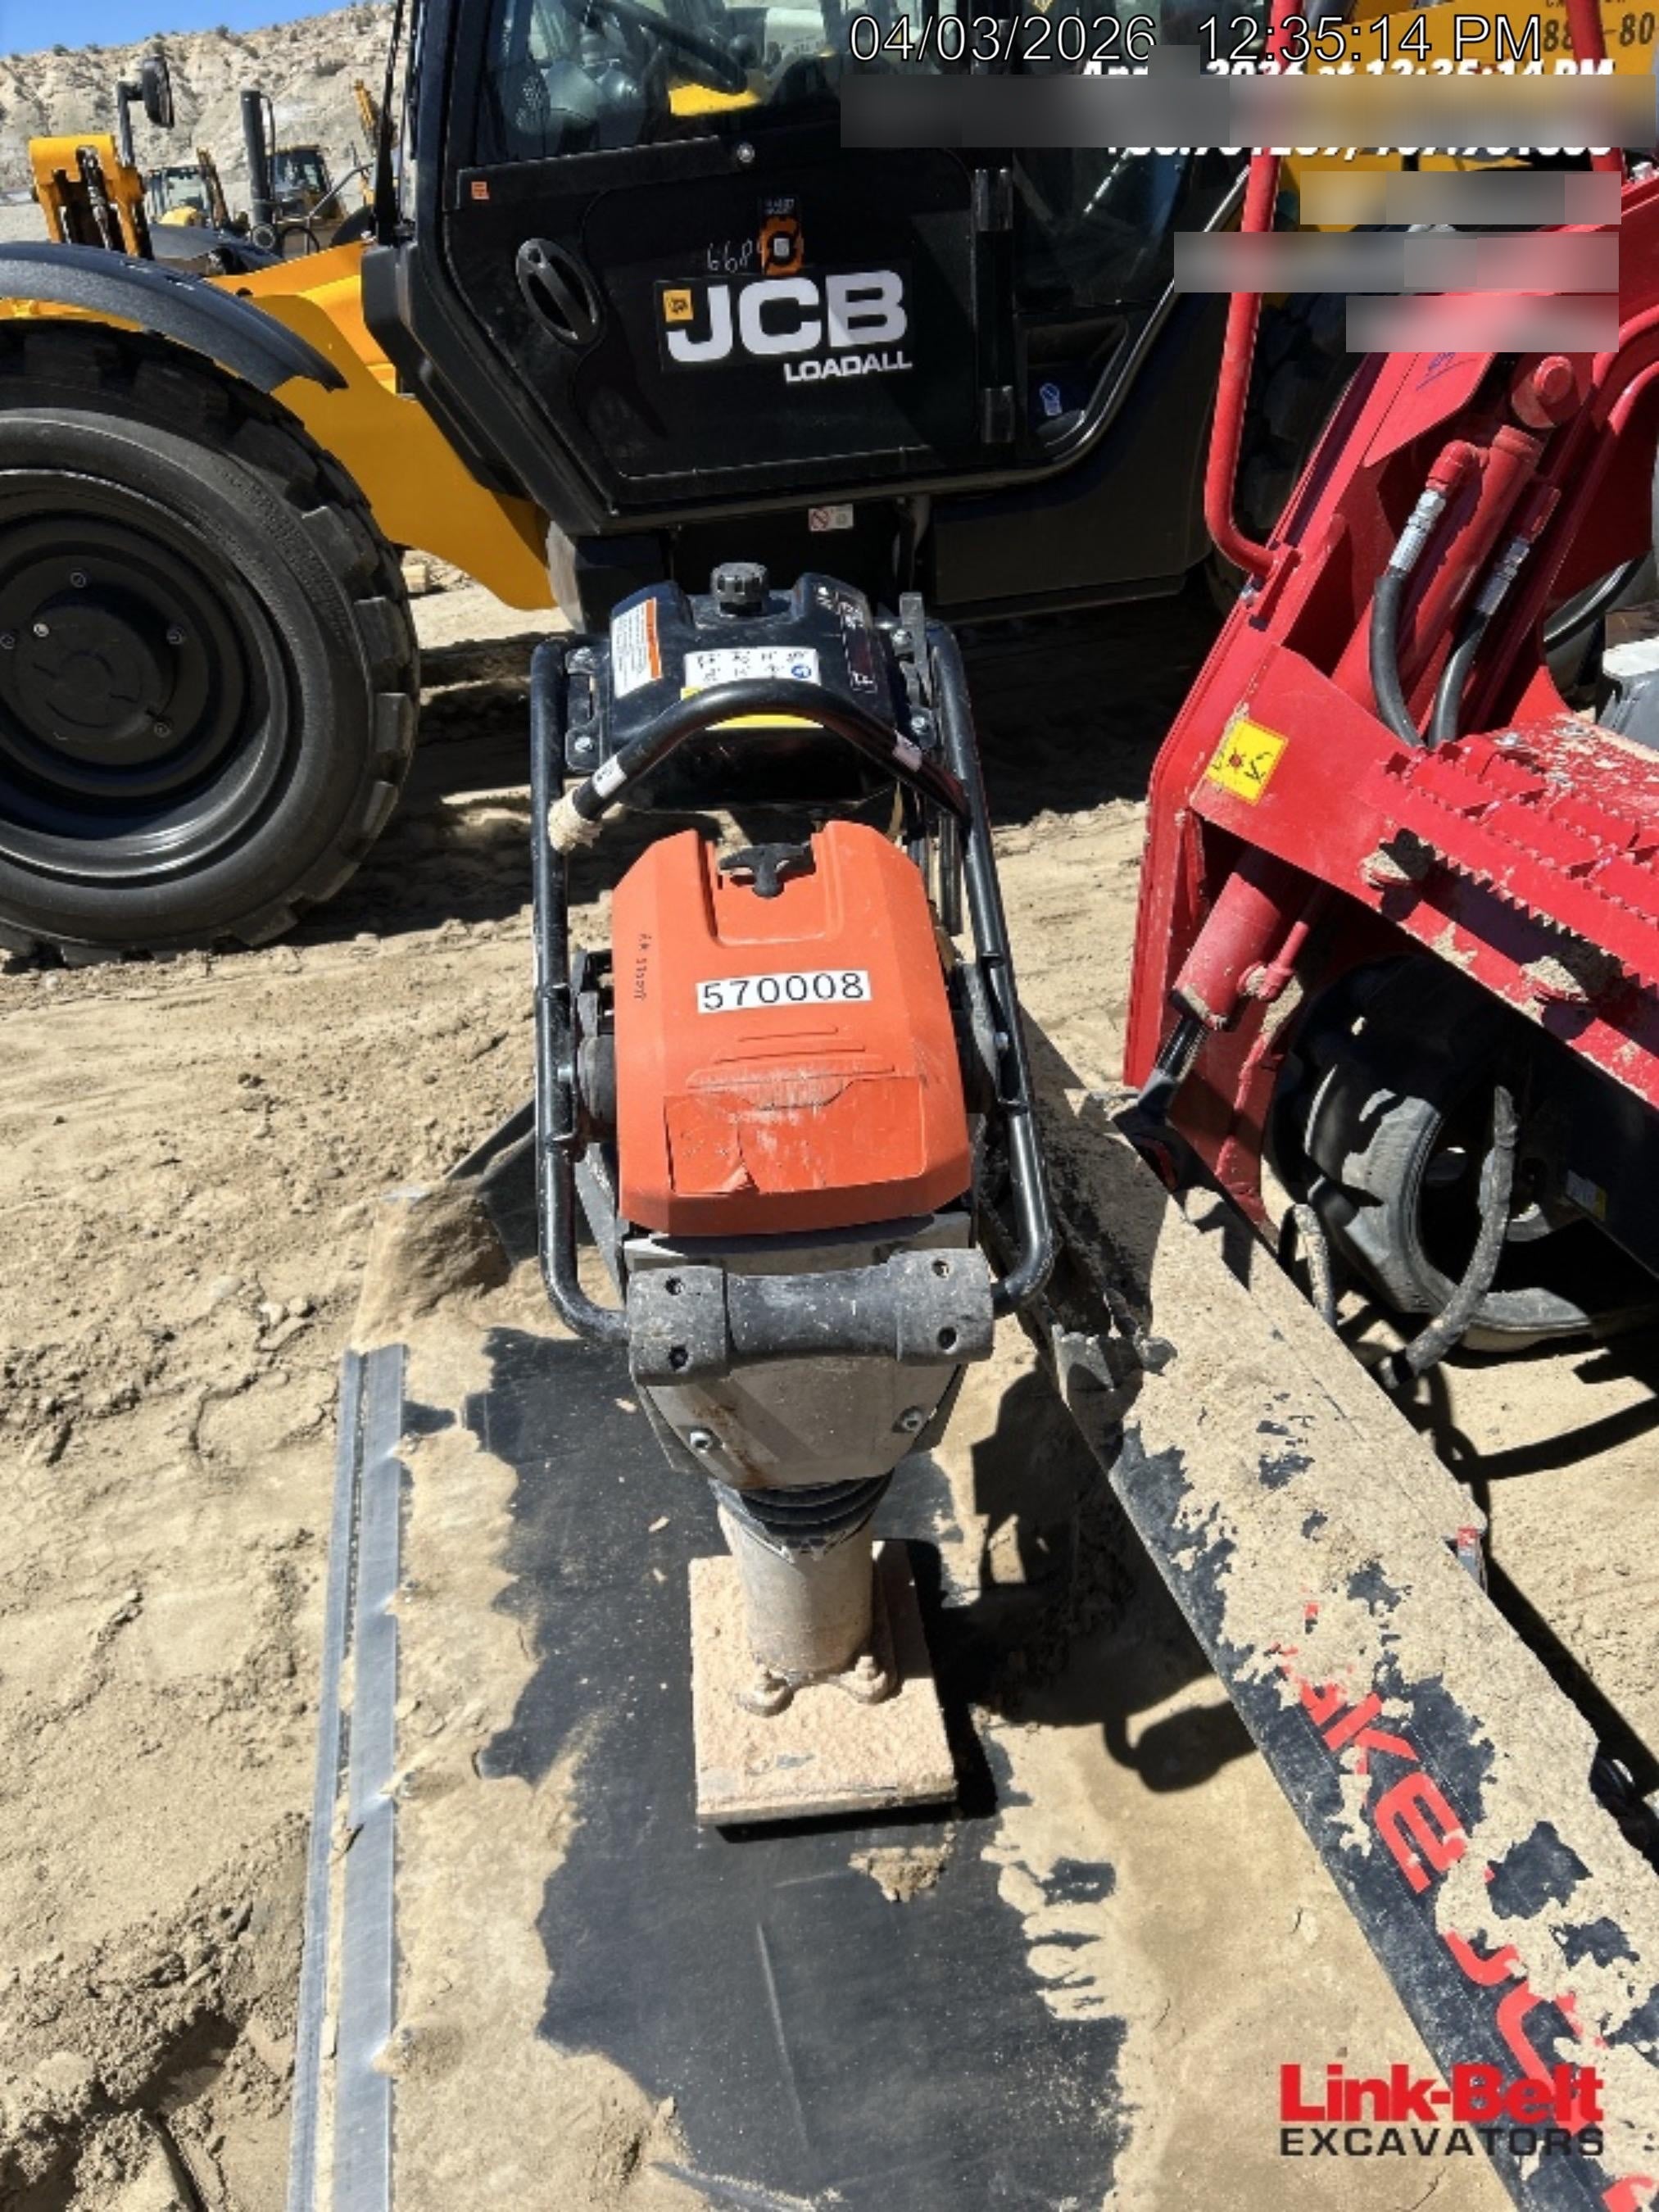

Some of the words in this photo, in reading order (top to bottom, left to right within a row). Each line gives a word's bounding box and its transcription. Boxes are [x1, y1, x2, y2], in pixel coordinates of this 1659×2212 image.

[666, 270, 908, 362] JCB
[783, 351, 913, 383] LOADALL
[704, 972, 863, 1010] 570008
